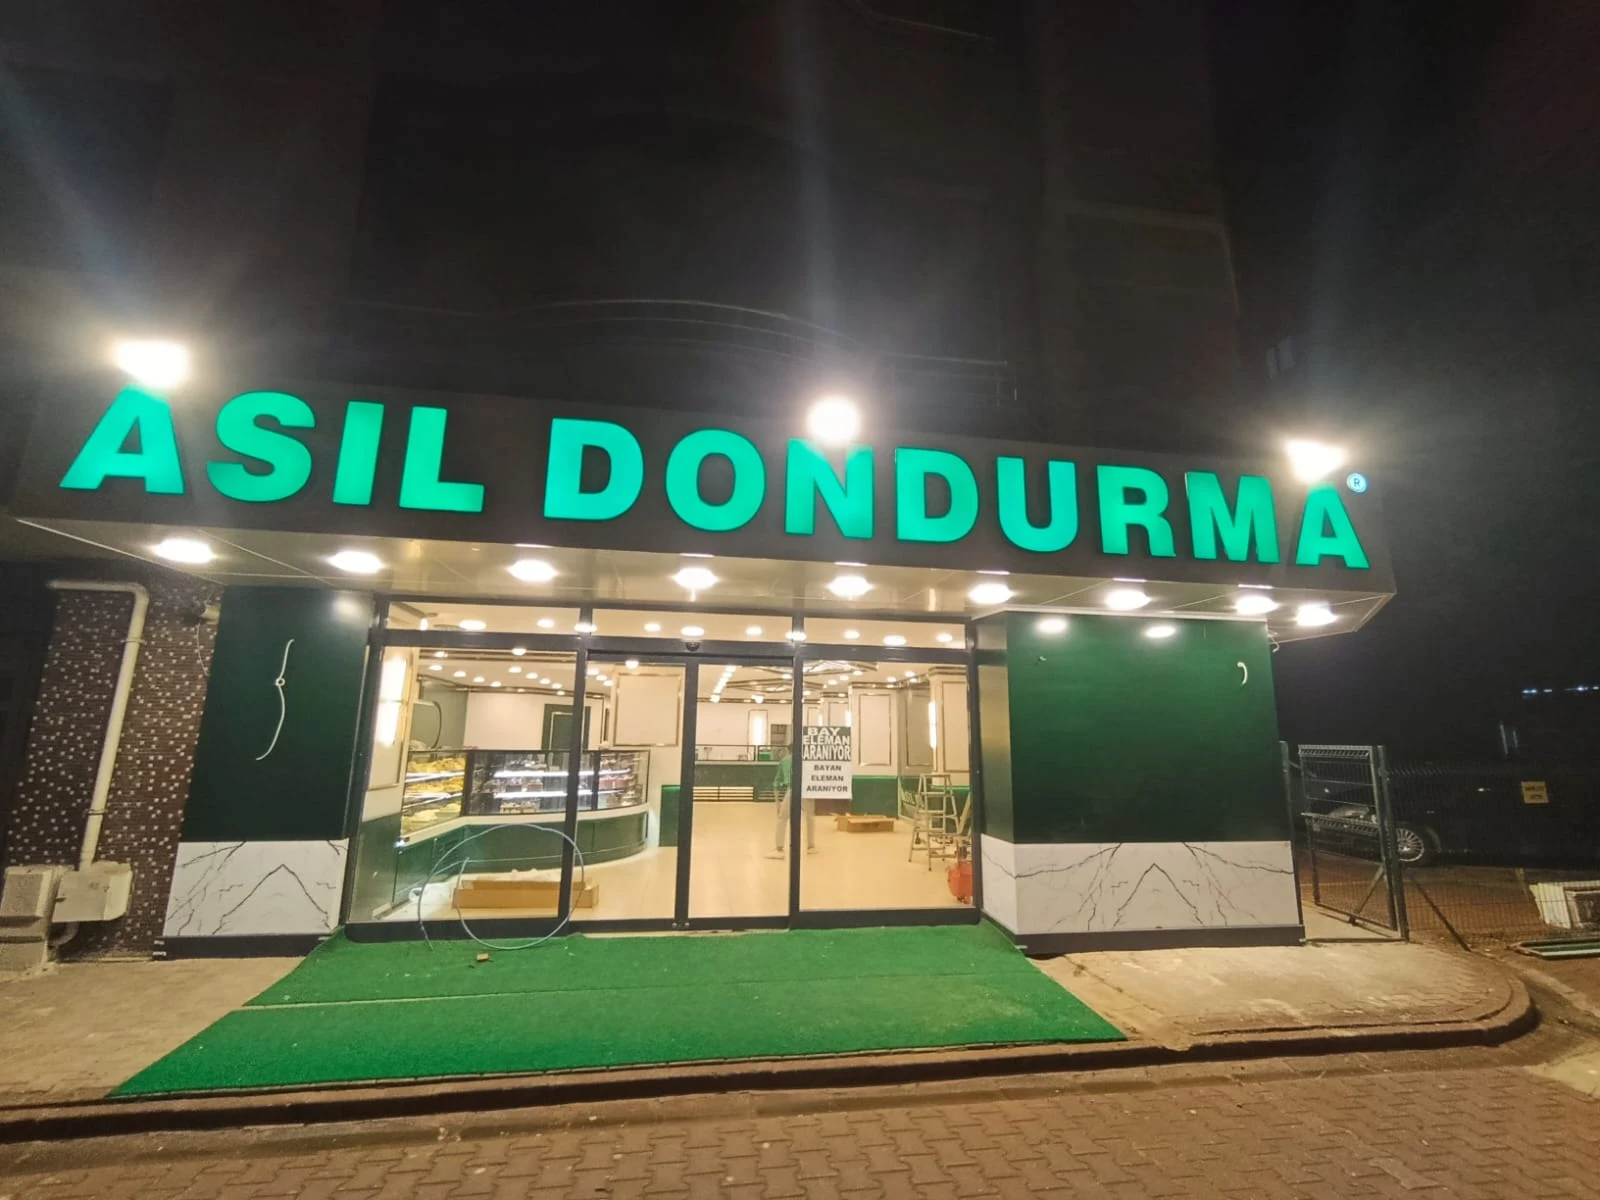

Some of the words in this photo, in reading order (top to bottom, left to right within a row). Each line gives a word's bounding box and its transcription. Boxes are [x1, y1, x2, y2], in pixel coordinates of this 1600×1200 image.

[59, 384, 485, 512] ASIL
[544, 417, 1370, 569] DONDURMA
[807, 727, 840, 736] BAY
[803, 735, 850, 745] ELEMAN
[803, 744, 851, 760] ARANIYOR
